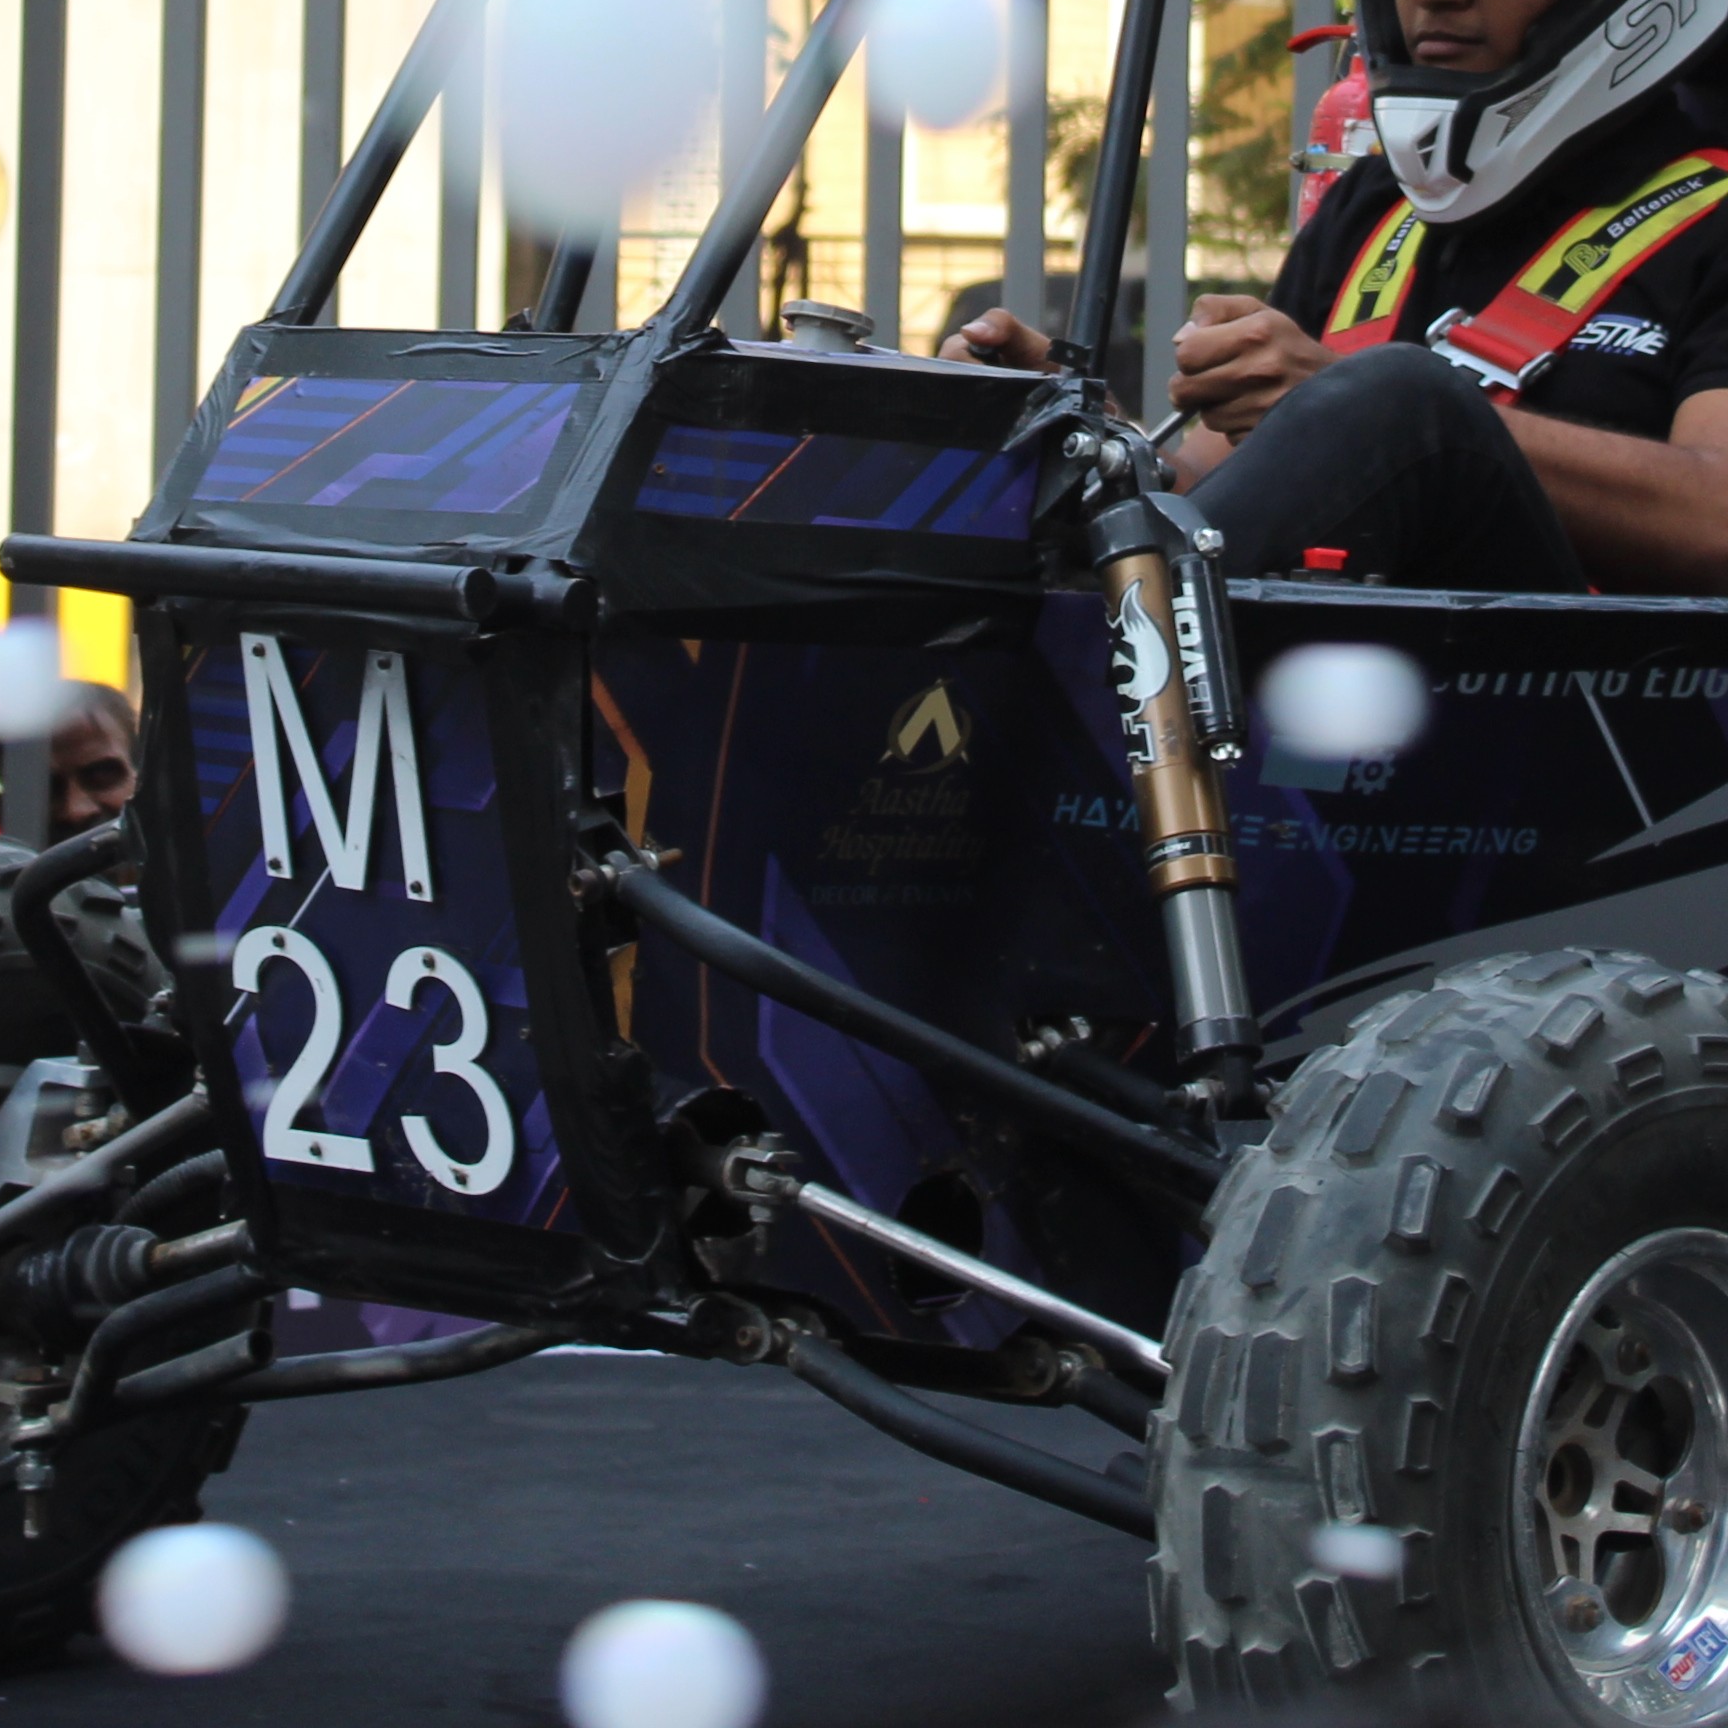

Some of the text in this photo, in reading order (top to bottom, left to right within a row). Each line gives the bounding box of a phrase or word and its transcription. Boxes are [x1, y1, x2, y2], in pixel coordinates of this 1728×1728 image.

[241, 632, 434, 903] M
[1275, 819, 1538, 857] ENGINEERING
[232, 925, 516, 1197] 23
